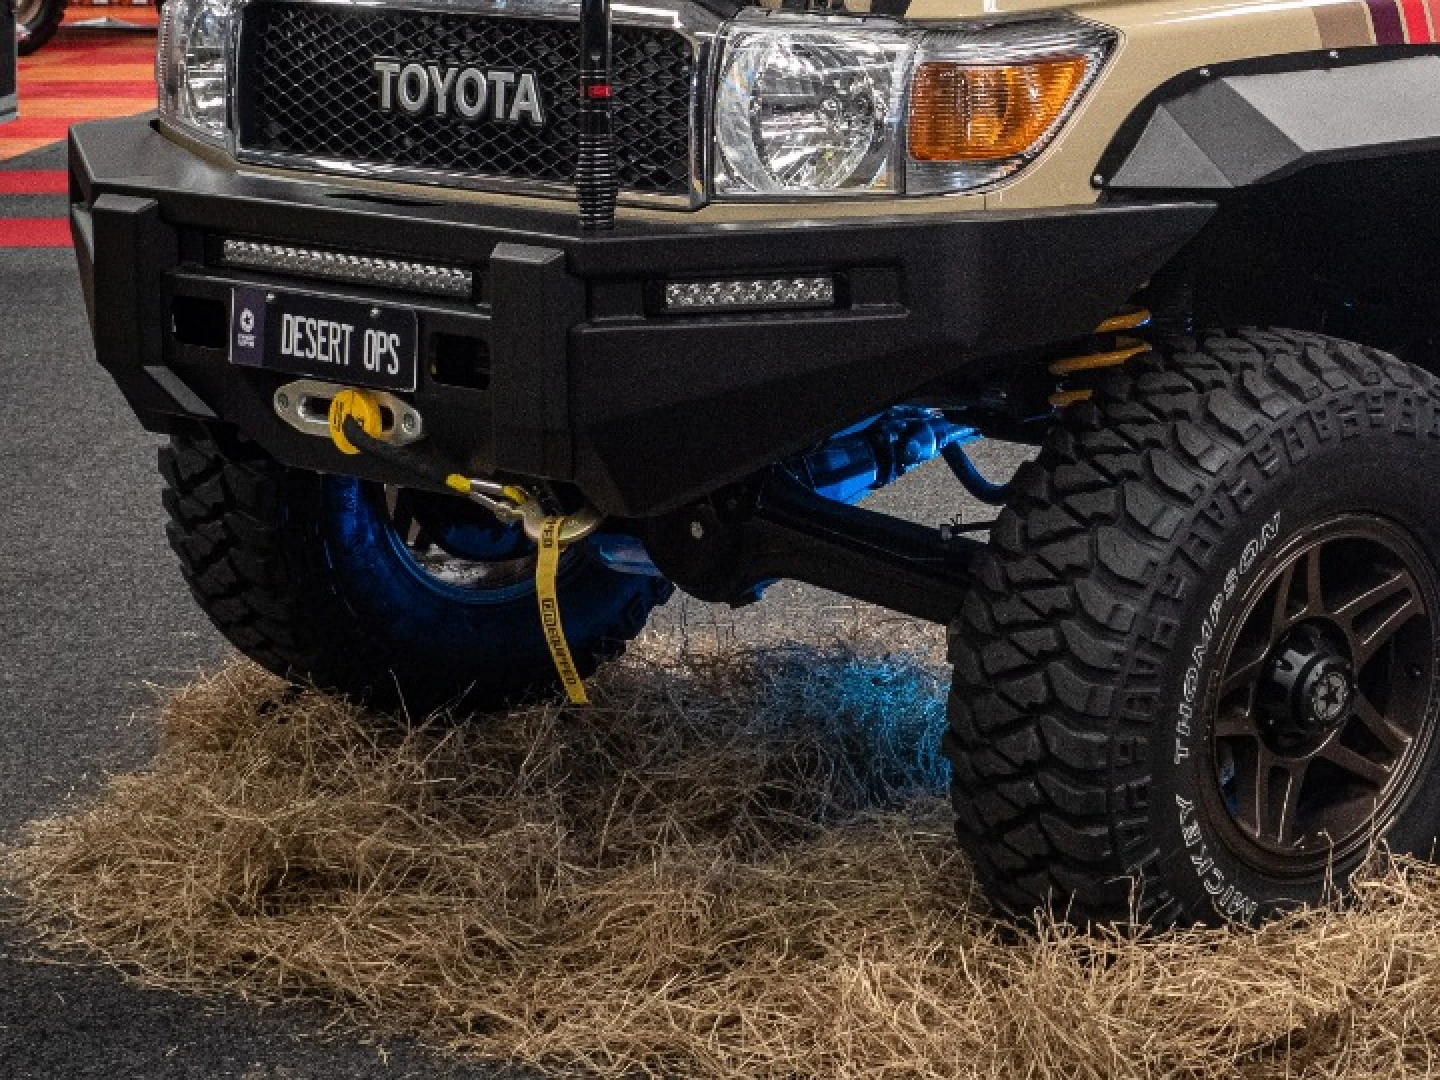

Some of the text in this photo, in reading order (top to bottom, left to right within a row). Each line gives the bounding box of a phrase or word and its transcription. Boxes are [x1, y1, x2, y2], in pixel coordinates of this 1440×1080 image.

[373, 60, 545, 125] TOYOTA
[281, 313, 401, 376] DESERT OPS
[1173, 511, 1282, 765] THOMPSON
